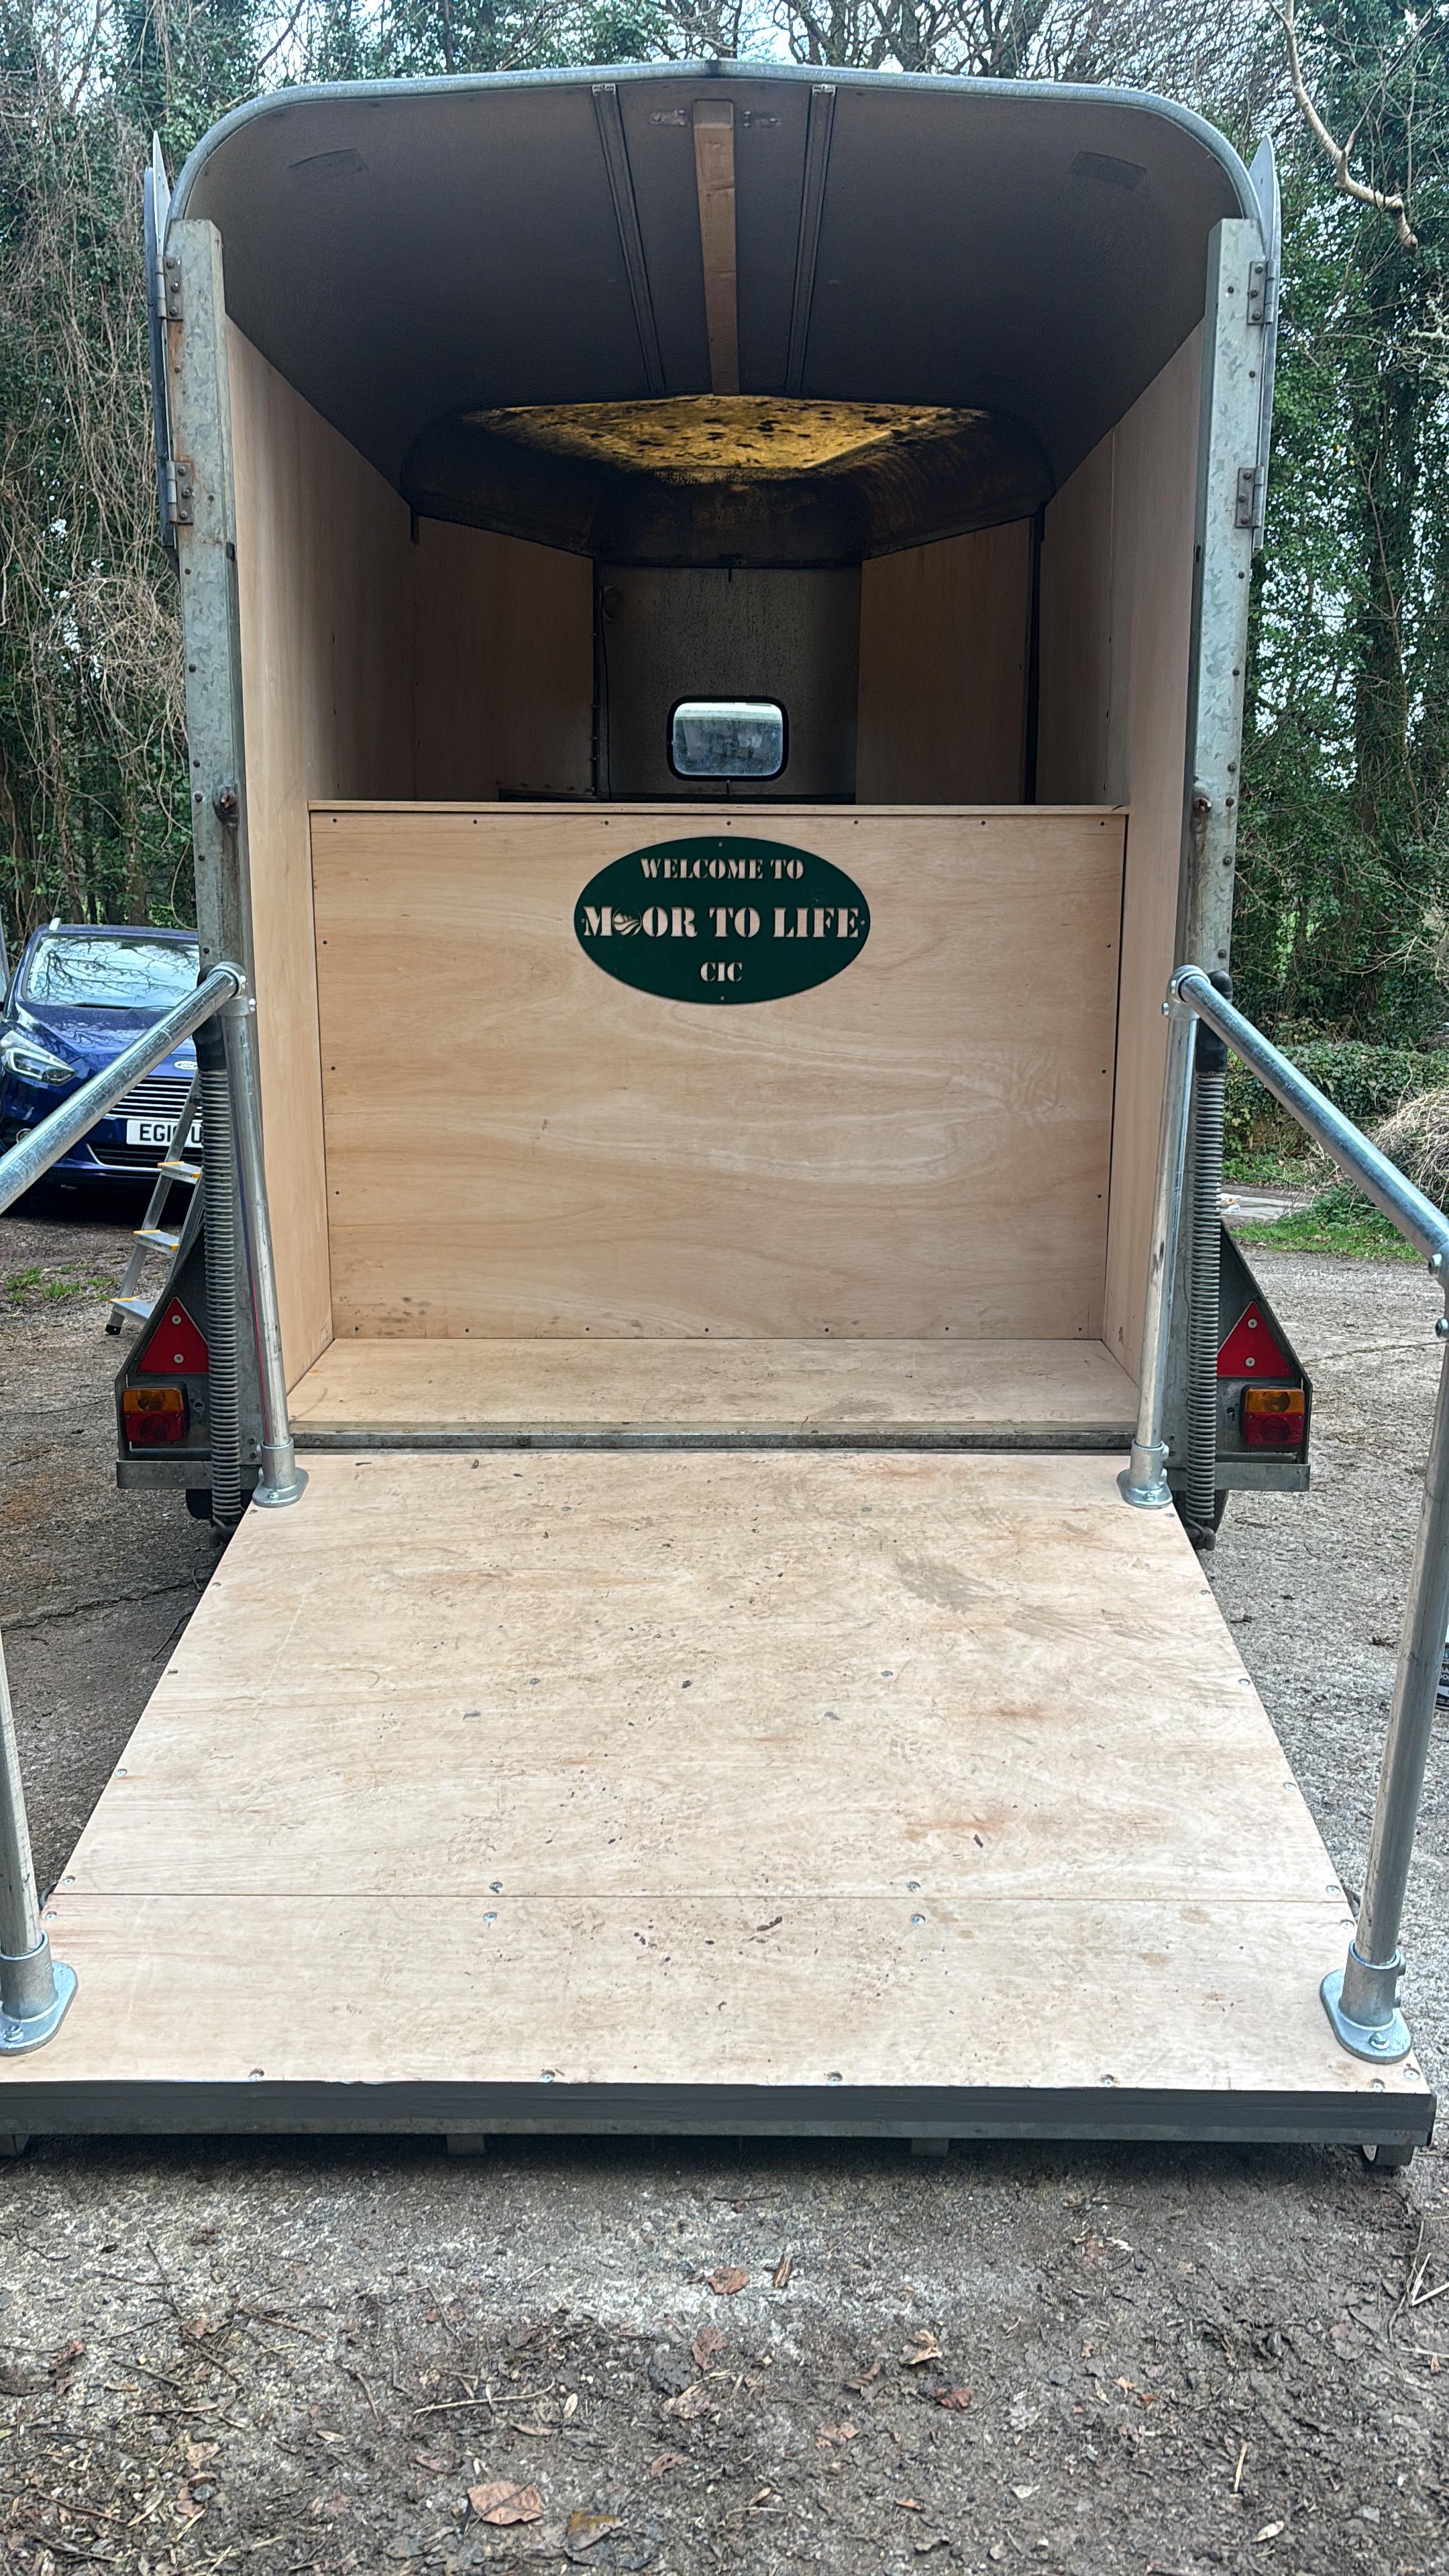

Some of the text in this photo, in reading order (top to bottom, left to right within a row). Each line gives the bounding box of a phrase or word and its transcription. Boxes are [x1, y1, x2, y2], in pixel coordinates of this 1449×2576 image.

[640, 858, 804, 879] WELCOME TO
[709, 907, 760, 938] TO
[773, 907, 859, 938] LIFE
[700, 961, 743, 982] CIC
